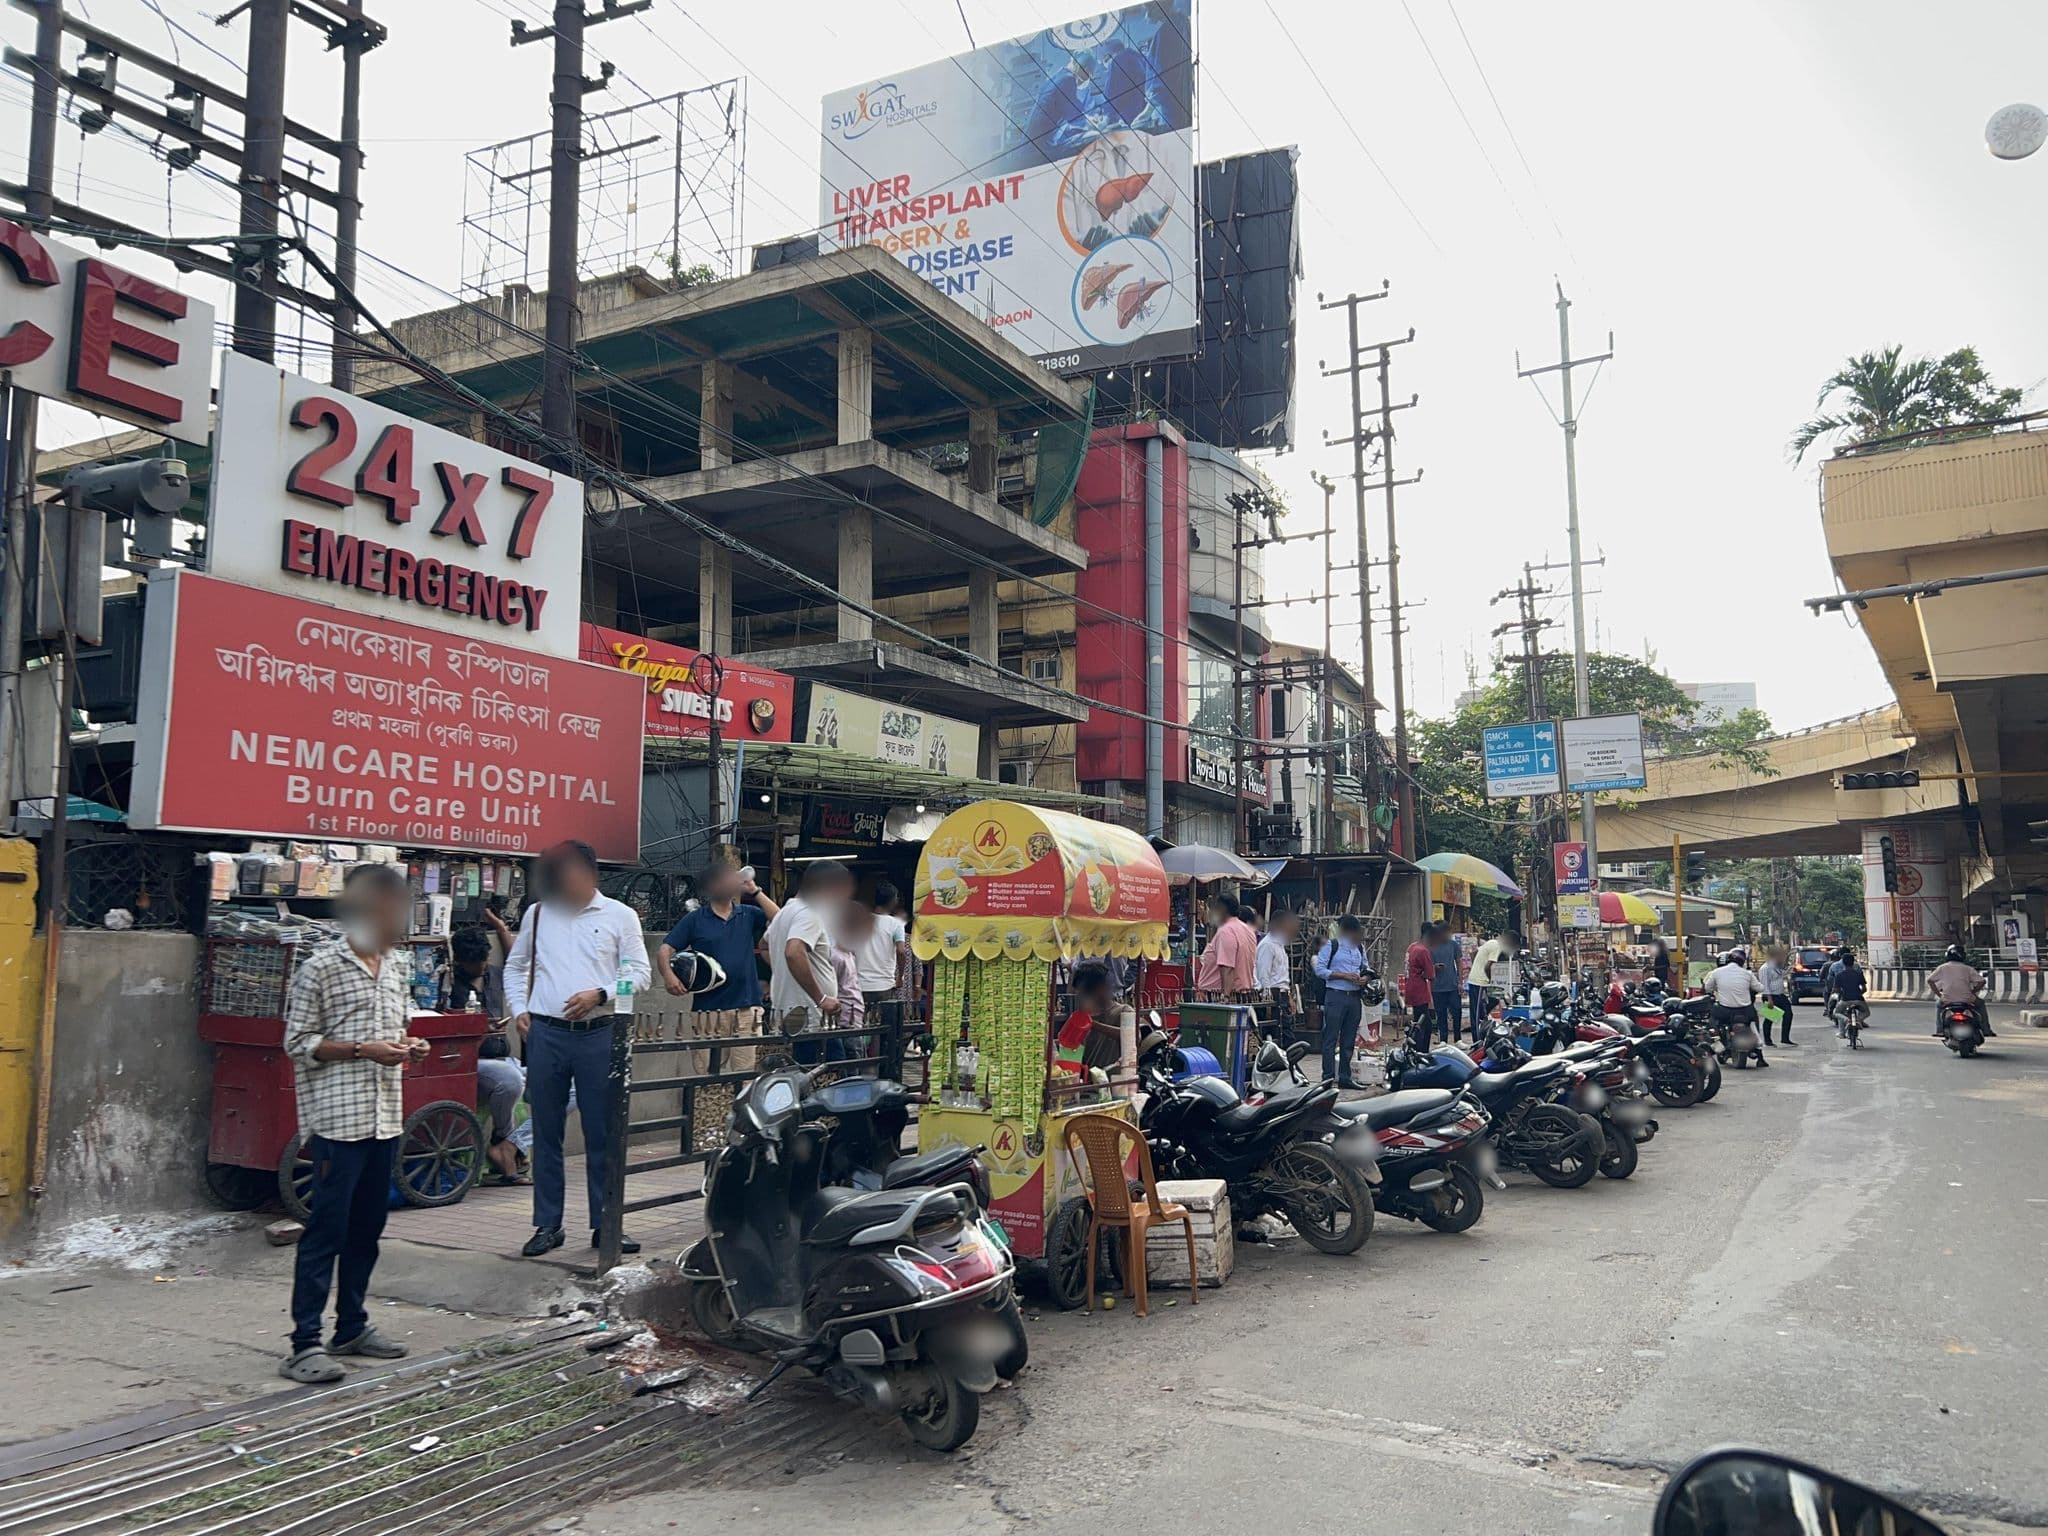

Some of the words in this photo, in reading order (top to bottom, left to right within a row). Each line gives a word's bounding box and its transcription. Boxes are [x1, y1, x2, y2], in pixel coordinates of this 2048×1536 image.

[834, 174, 910, 215] LIVER
[838, 174, 1025, 240] TRANSPLANT
[954, 218, 971, 241] &
[907, 234, 1014, 275] DISEASE
[286, 396, 420, 524] 24
[501, 466, 554, 560] 7
[282, 519, 548, 631] EMERGENCY
[1486, 730, 1509, 741] GMCH
[230, 729, 439, 785] NEMCARE
[453, 760, 616, 806] HOSPITAL
[1195, 758, 1216, 782] Royal
[1248, 773, 1267, 797] House
[1511, 754, 1530, 765] BAZAR
[286, 774, 374, 810] Burn
[388, 786, 466, 819] Care
[481, 797, 542, 827] Unit
[306, 812, 338, 832] 1st
[346, 816, 399, 836] Floor
[406, 821, 443, 841] (Old
[450, 825, 528, 850] Building)
[854, 812, 884, 839] Joint
[978, 827, 1001, 847] AK
